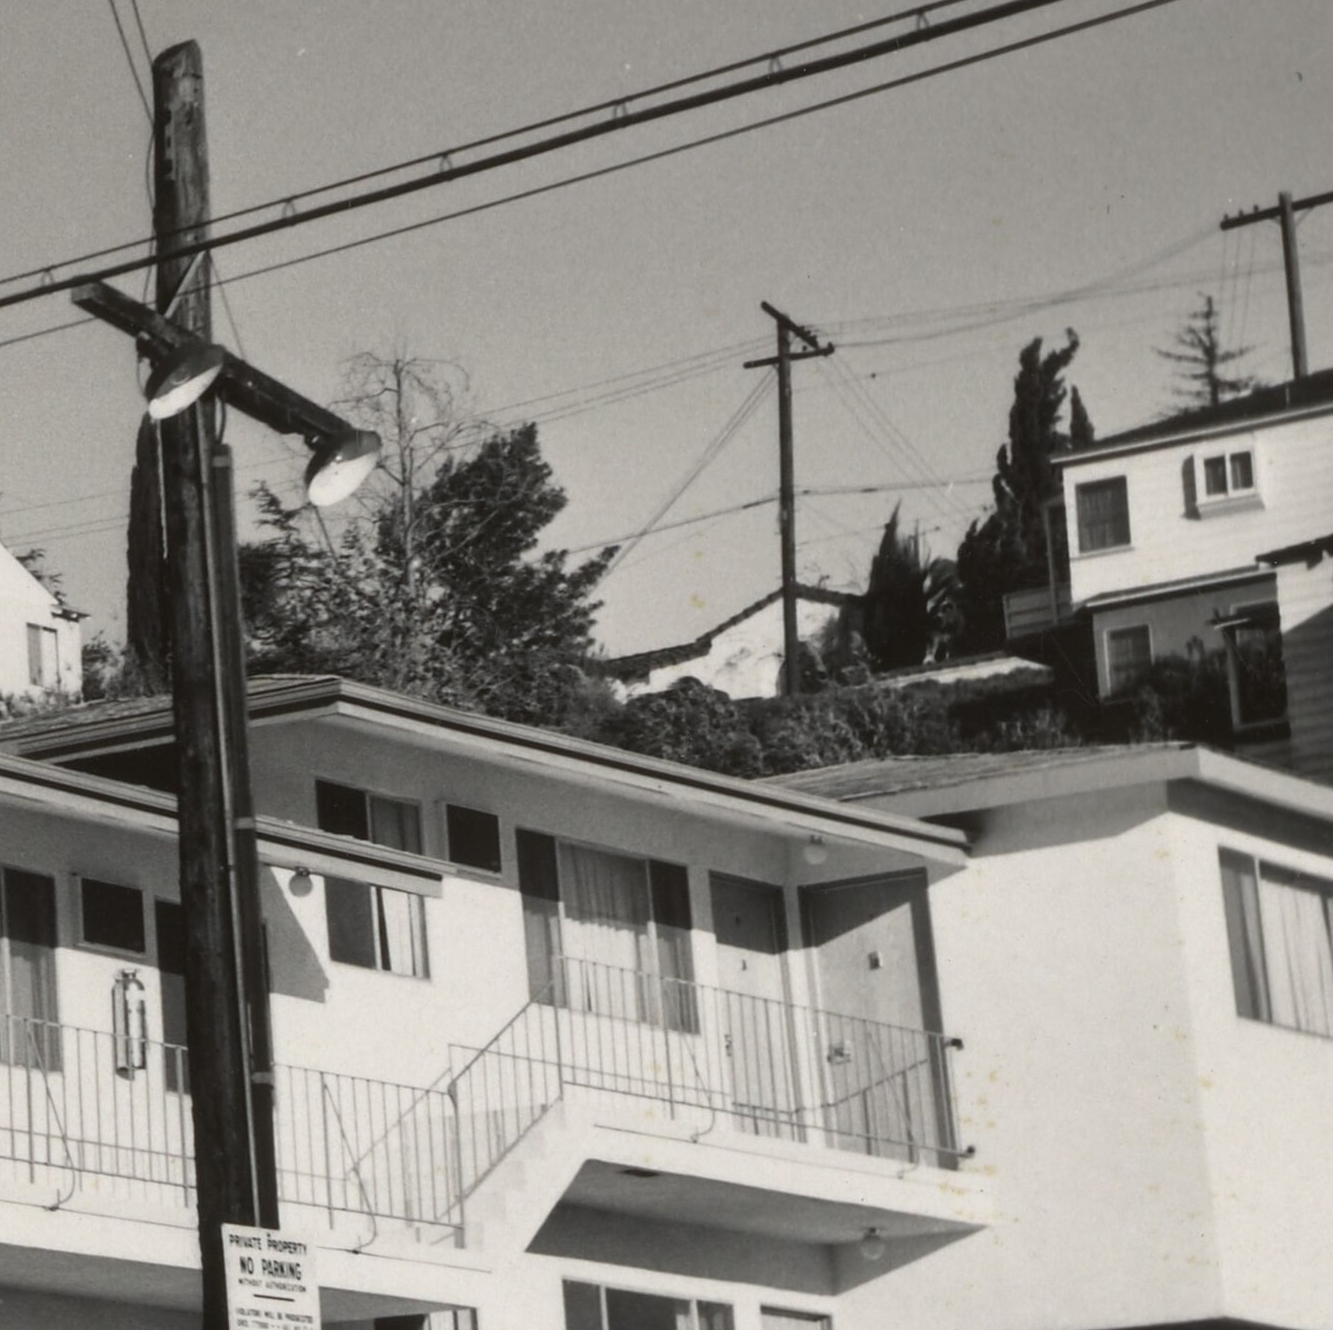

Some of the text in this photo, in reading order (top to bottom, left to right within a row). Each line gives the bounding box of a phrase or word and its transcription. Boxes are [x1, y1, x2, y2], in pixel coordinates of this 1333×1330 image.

[229, 1234, 307, 1256] PRIVATE PROPERTY
[239, 1256, 302, 1281] NO PARKING
